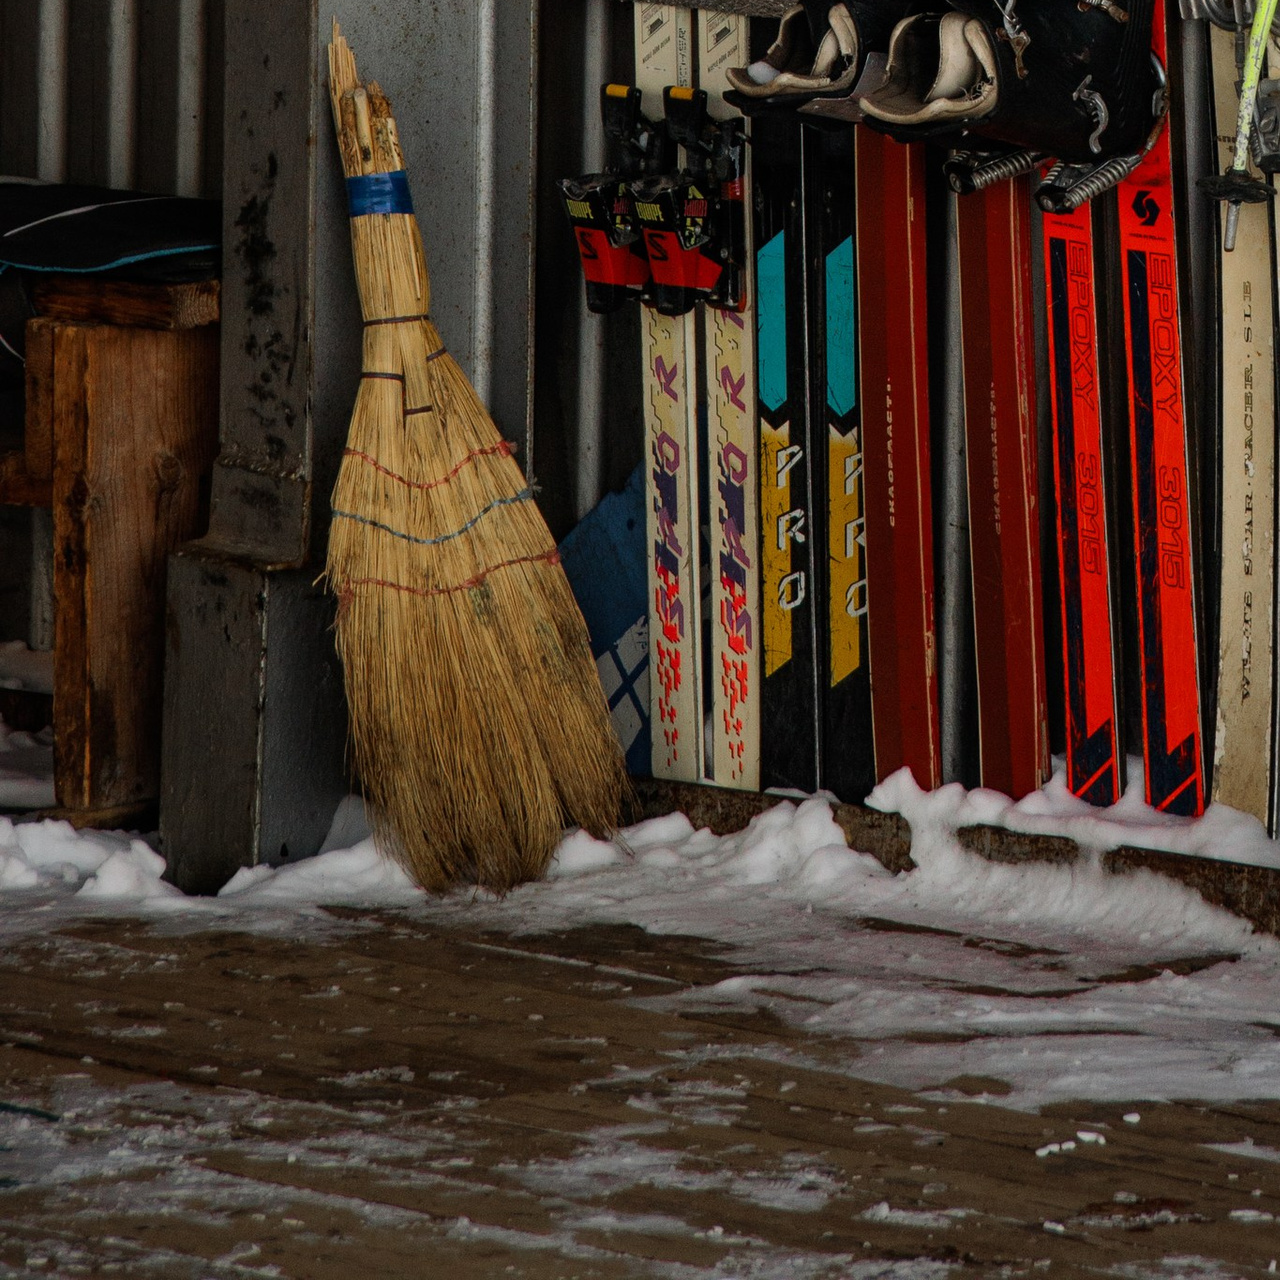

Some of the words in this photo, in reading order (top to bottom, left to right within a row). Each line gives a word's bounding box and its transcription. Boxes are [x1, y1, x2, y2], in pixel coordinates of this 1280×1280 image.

[1068, 240, 1094, 410] EPOXY
[1150, 251, 1178, 422] EPOXY
[1242, 285, 1254, 348] SLE
[656, 318, 687, 639] SPOR
[776, 443, 806, 611] PRO
[1077, 453, 1101, 575] 3015
[1159, 466, 1184, 590] 3015
